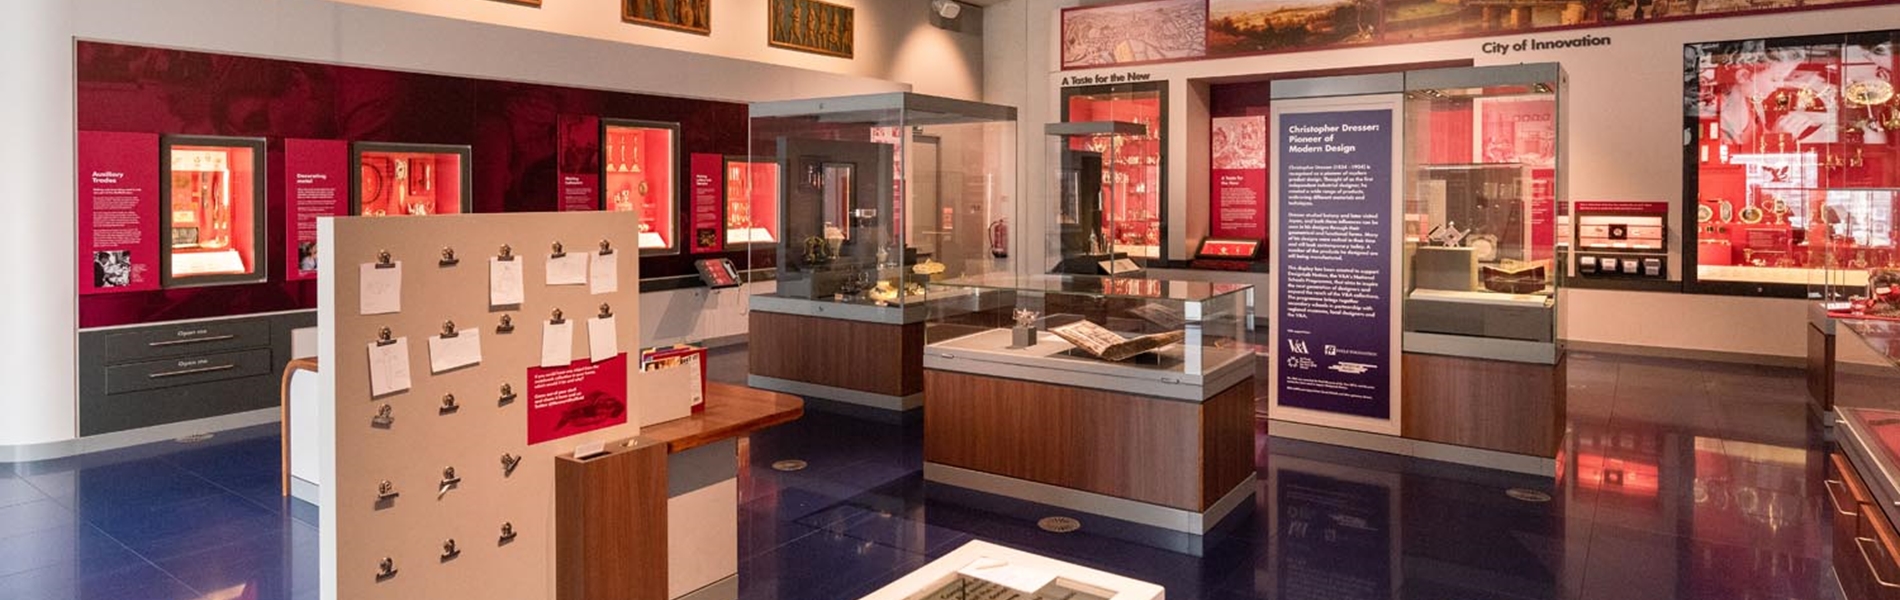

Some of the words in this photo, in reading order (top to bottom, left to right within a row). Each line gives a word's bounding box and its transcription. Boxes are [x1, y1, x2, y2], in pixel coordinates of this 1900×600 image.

[1482, 41, 1509, 55] City
[1512, 39, 1527, 51] of
[1531, 34, 1611, 51] Innovation
[1061, 77, 1069, 86] A
[1071, 76, 1093, 85] Taste
[1095, 74, 1108, 84] for
[1110, 72, 1125, 82] the
[1127, 71, 1151, 82] New
[1288, 124, 1339, 135] Christopher
[1341, 124, 1379, 132] Dresser:
[1288, 135, 1321, 144] Pioneer
[1324, 134, 1334, 143] of
[1288, 145, 1323, 153] Modern
[1325, 144, 1356, 154] Design
[92, 171, 124, 180] Auxiliary
[1288, 339, 1309, 354] V&A
